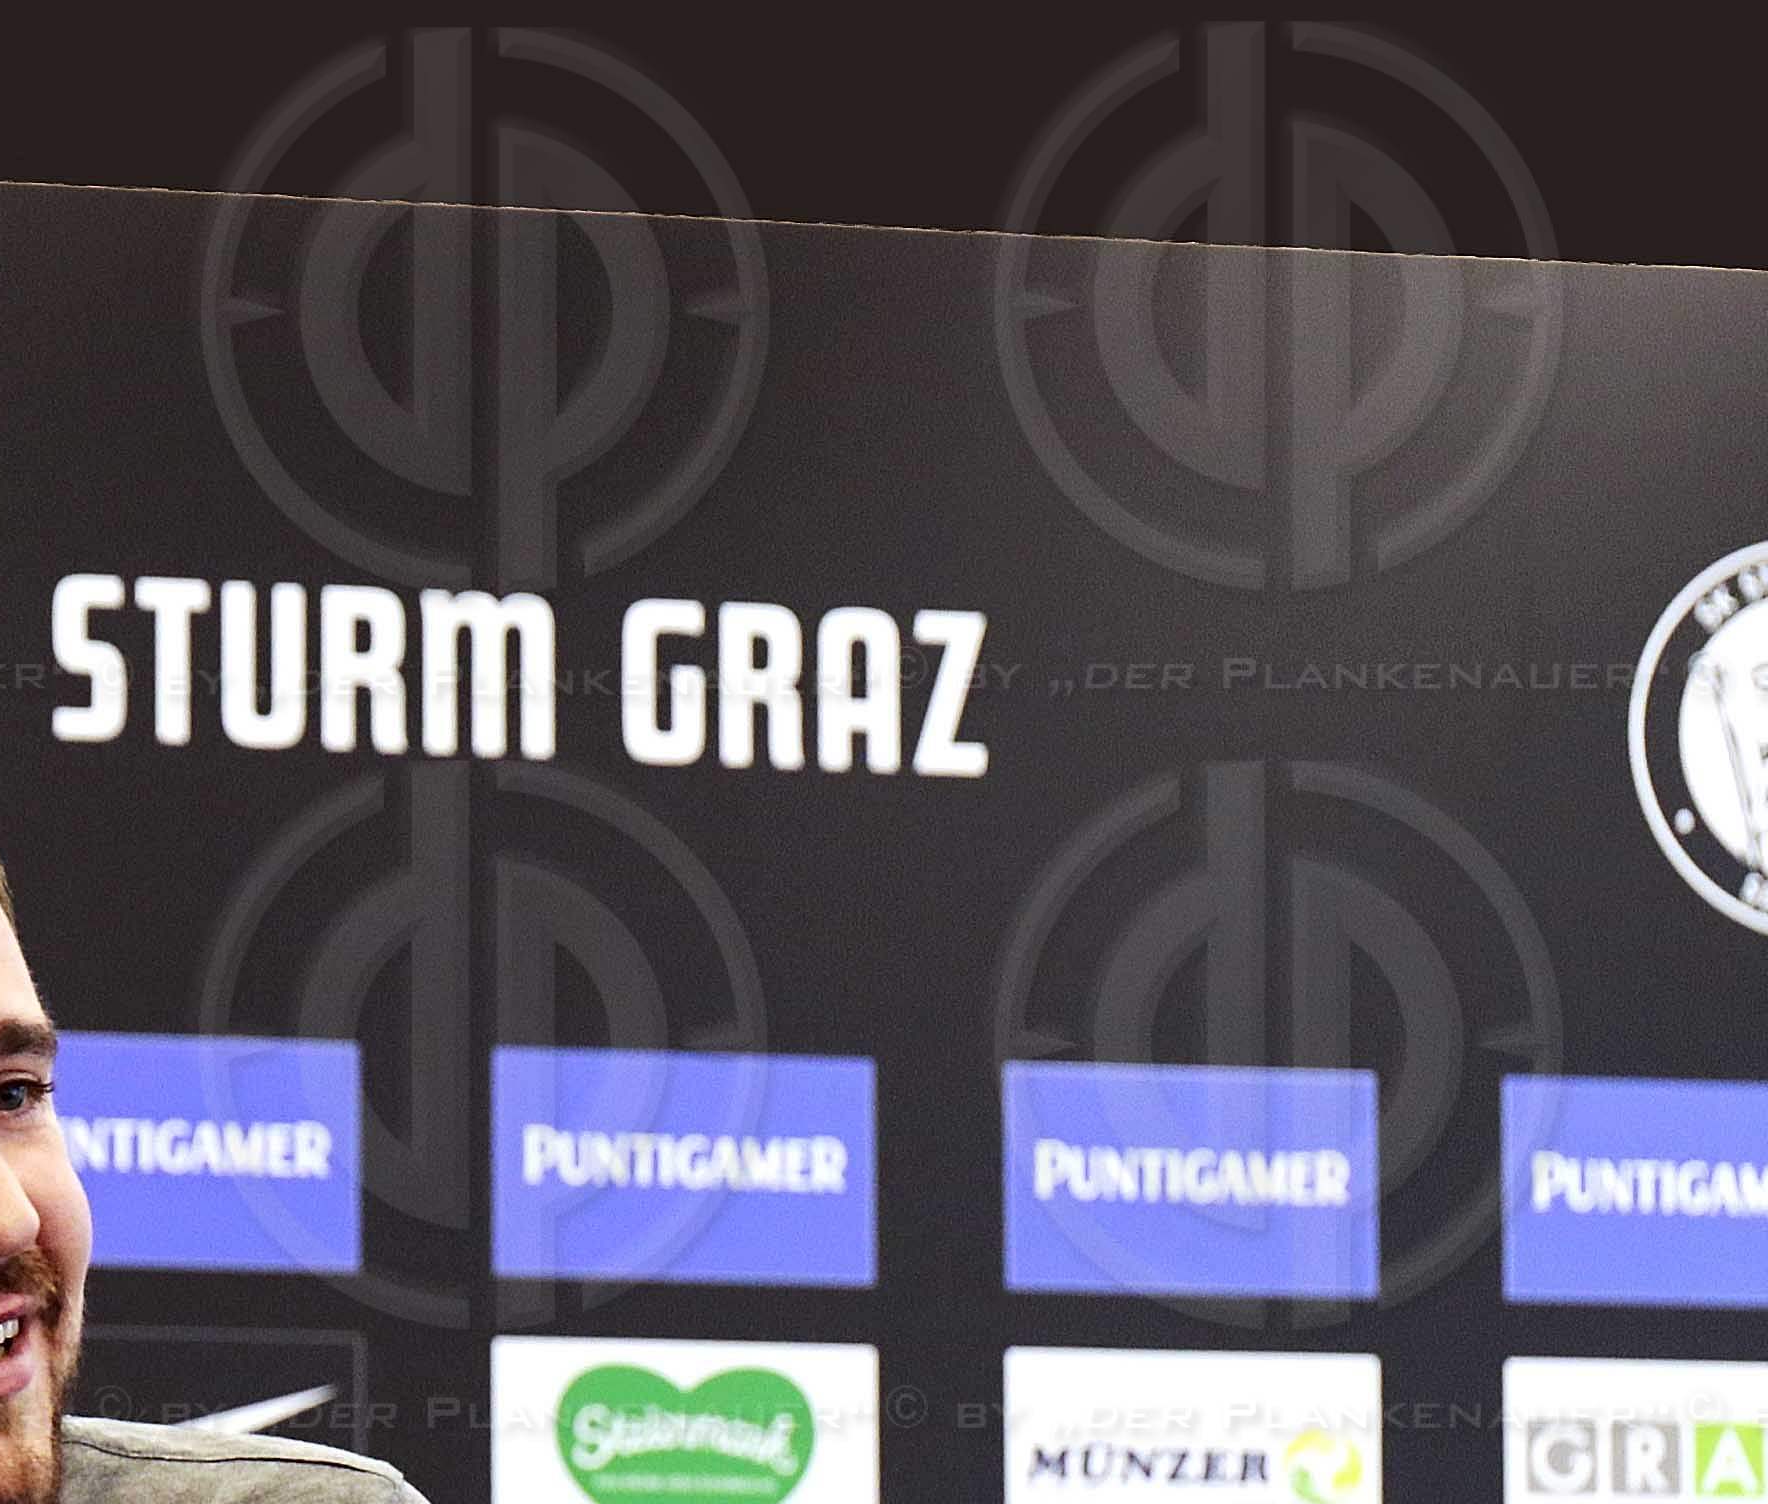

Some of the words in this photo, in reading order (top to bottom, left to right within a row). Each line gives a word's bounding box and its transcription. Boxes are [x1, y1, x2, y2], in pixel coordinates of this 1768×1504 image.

[51, 572, 558, 760] STURM
[621, 598, 989, 778] GRAZ
[521, 1122, 848, 1195] PUNTIGAMER
[1033, 1138, 1351, 1209] PUNTIGAMER
